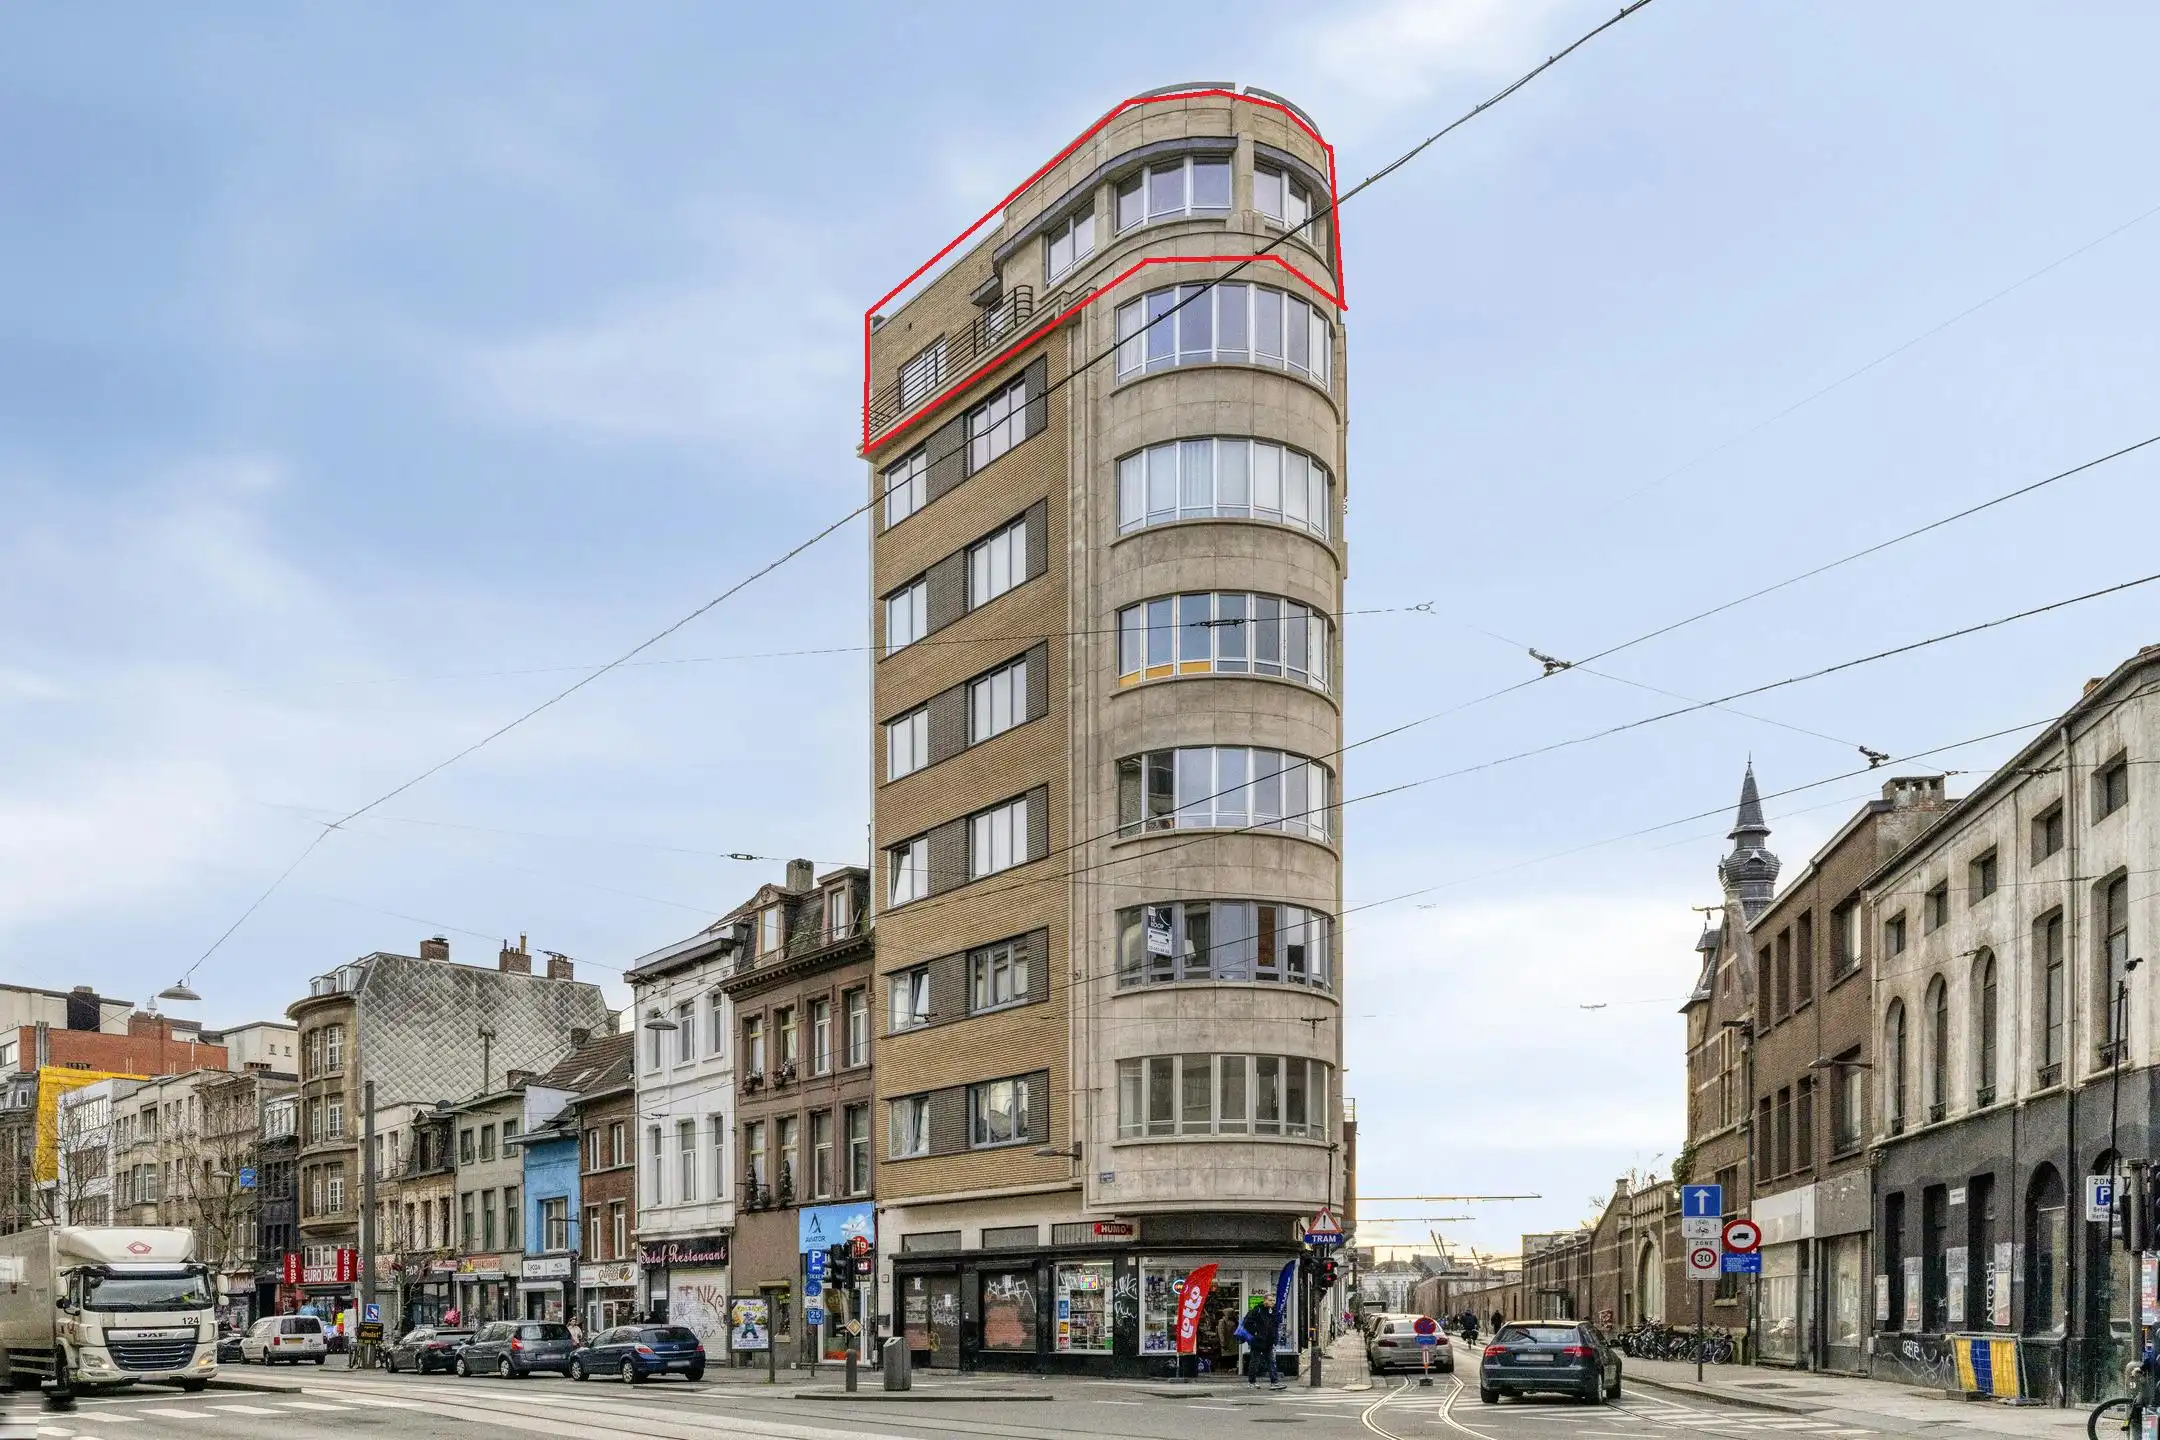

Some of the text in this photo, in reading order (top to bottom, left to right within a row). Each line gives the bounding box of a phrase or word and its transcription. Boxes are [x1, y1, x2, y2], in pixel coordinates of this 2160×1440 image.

[1101, 1224, 1126, 1233] HUMO
[668, 1243, 726, 1263] Restaurant
[1697, 1254, 1711, 1263] 30
[303, 1269, 321, 1282] EURO
[810, 1311, 821, 1319] 25
[182, 1316, 199, 1325] 124
